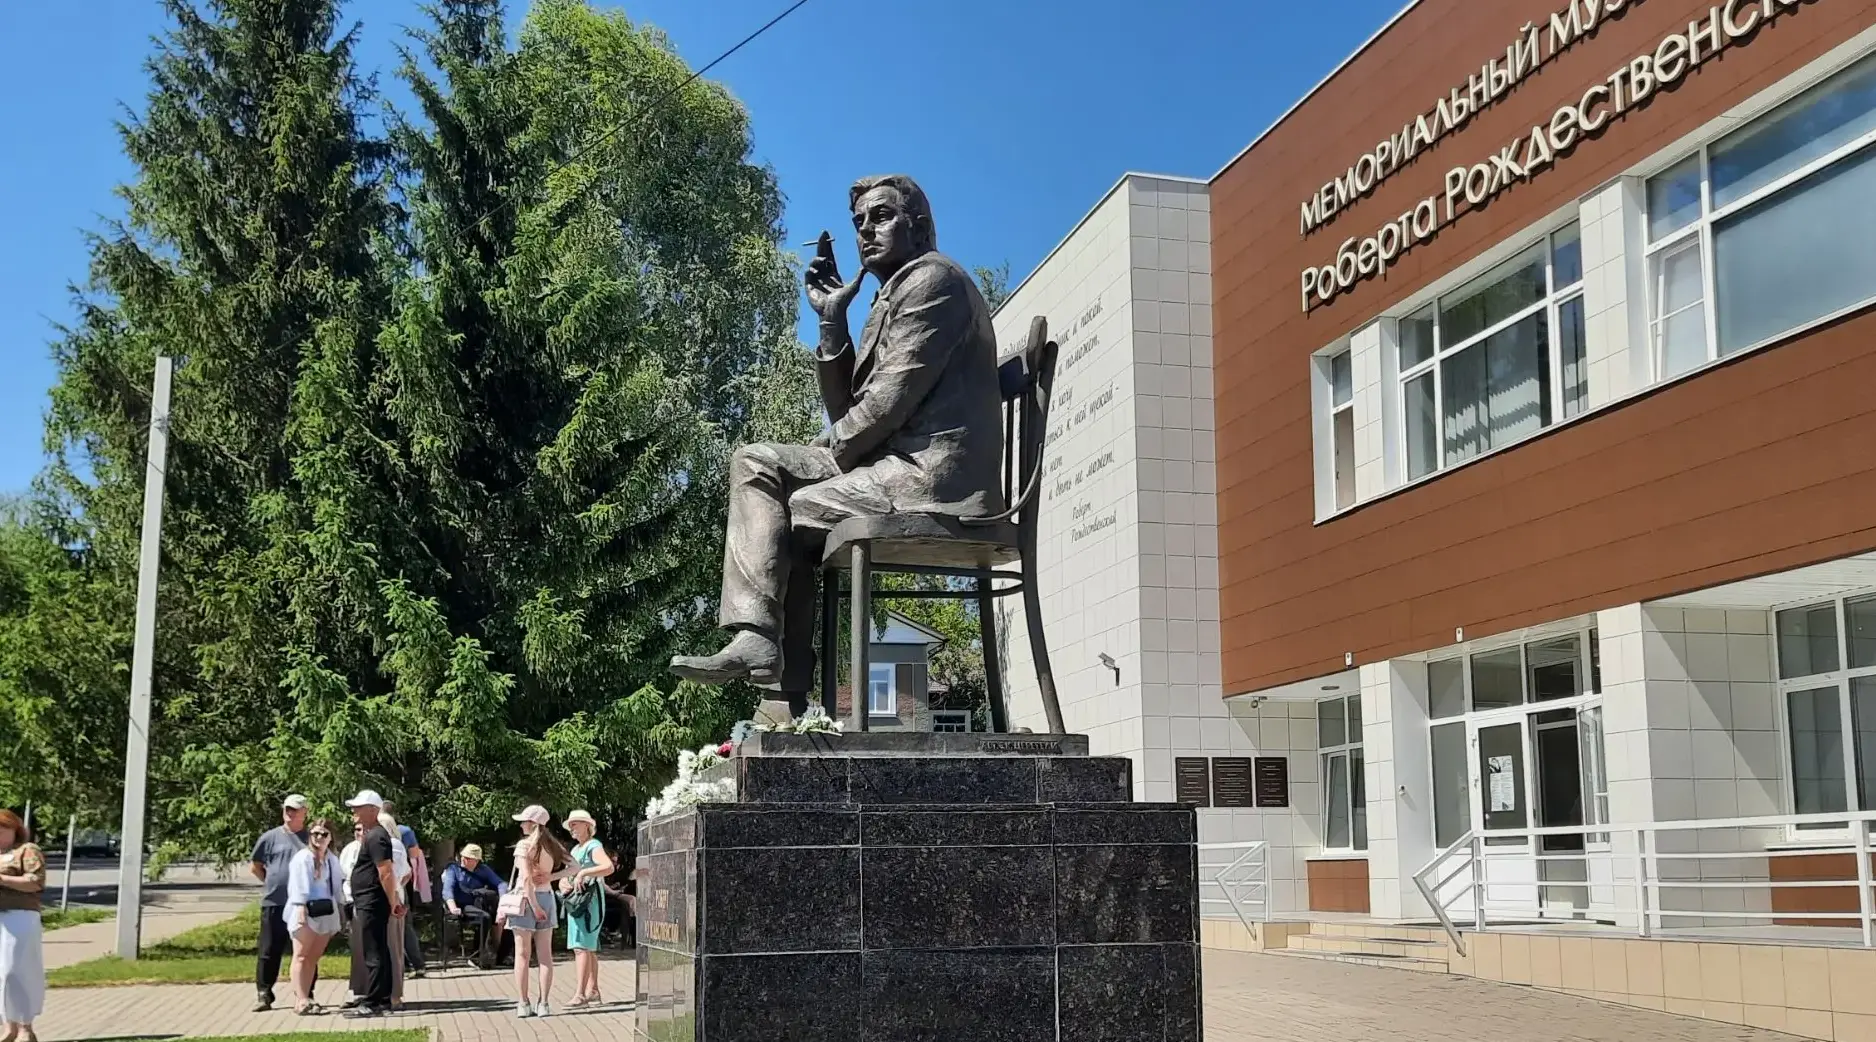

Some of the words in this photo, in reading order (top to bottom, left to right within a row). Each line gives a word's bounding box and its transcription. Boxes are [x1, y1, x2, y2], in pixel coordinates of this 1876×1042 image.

[1299, 22, 1541, 235] МЕМОРИАЛЬНЫЙ
[1550, 0, 1624, 55] МУ
[1301, 196, 1435, 312] Роберта
